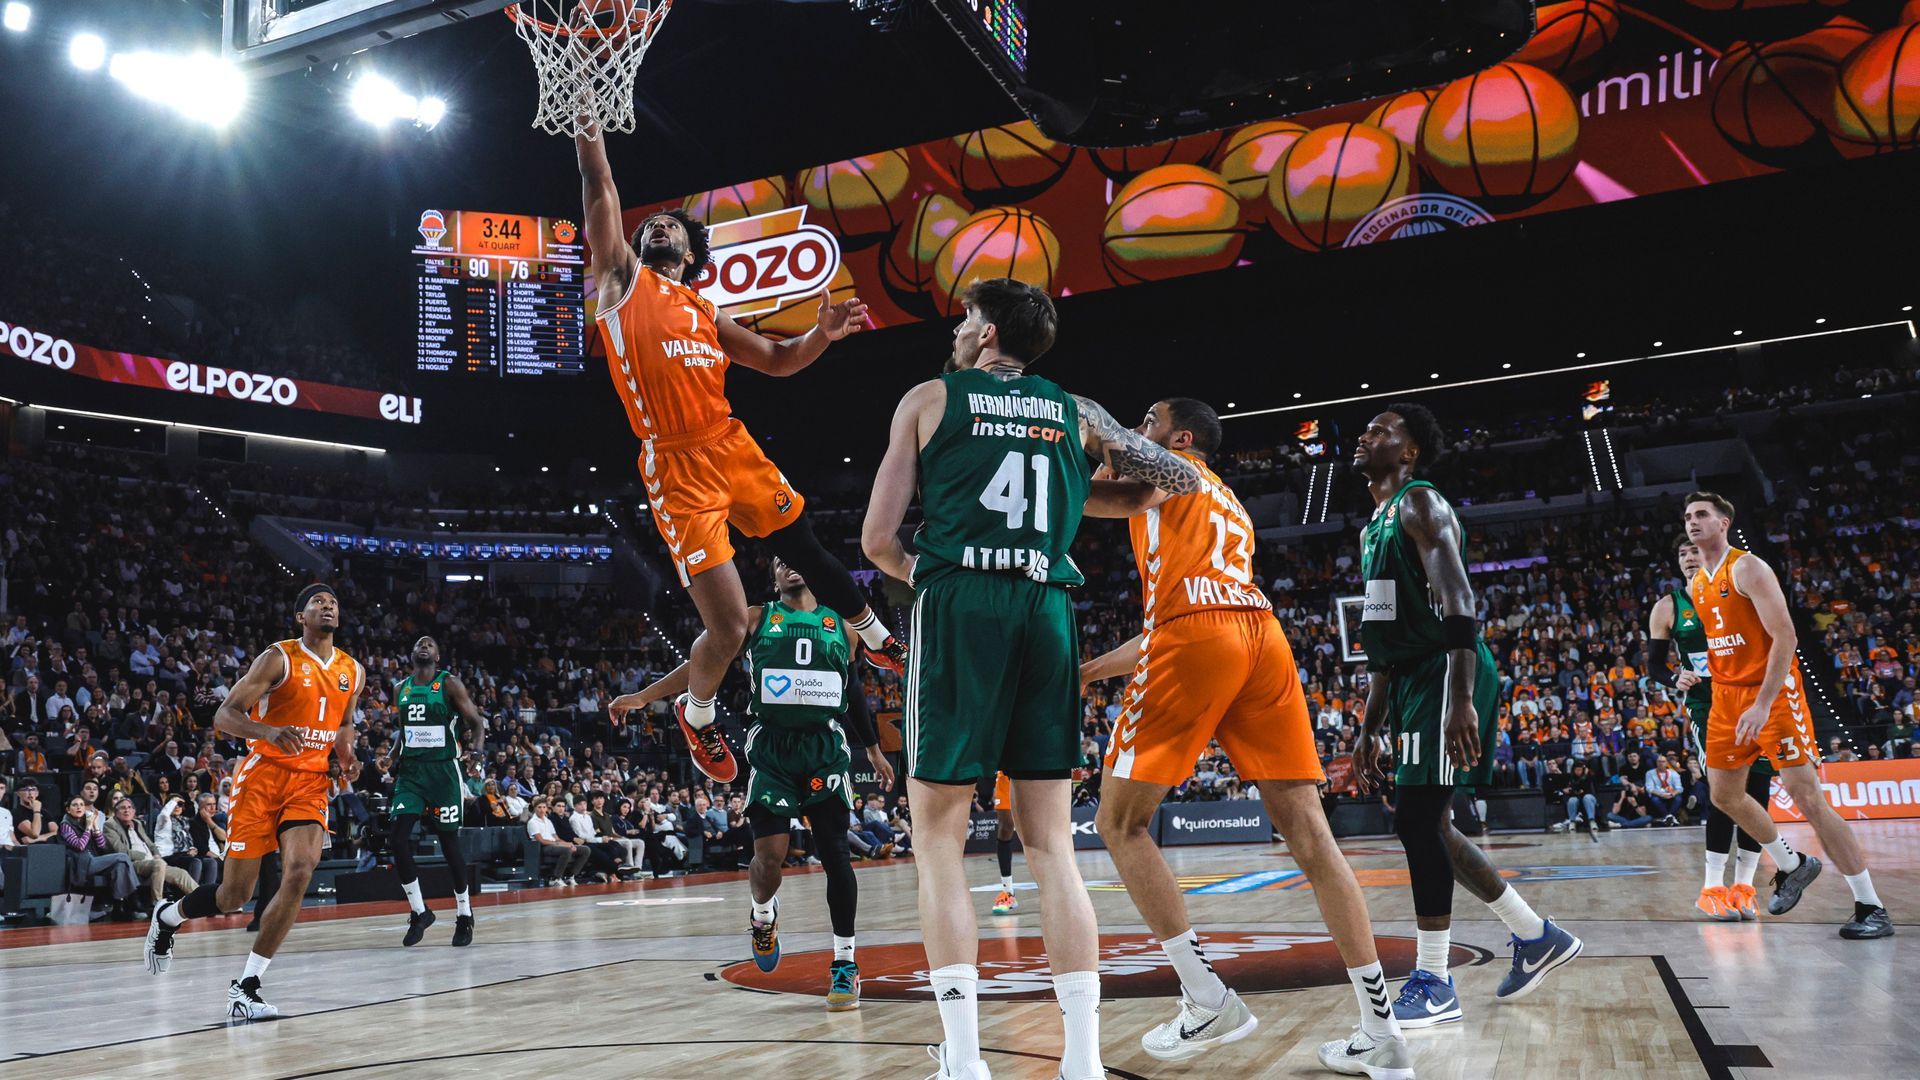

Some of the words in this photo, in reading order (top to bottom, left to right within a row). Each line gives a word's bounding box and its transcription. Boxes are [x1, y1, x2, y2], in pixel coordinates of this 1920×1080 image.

[1581, 48, 1720, 118] mili
[482, 218, 521, 240] 3:44
[1359, 204, 1439, 242] ROCINADOR
[1445, 206, 1480, 226] OFIC
[491, 242, 520, 250] QUART
[469, 258, 488, 278] 90
[509, 260, 528, 280] 76
[684, 305, 698, 332] 7
[968, 393, 1064, 424] HERNANGOMEZ
[972, 416, 1065, 443] instacar
[978, 450, 1050, 532] 41
[1210, 511, 1250, 585] 13
[962, 546, 1049, 583] ATHENS
[1712, 606, 1724, 630] 3
[795, 638, 812, 665] 0
[1708, 633, 1746, 649] LENCIA
[795, 678, 822, 687] Ομάδα
[795, 689, 840, 699] Προσφοράς
[318, 696, 327, 722] 1
[408, 704, 426, 721] 22
[290, 725, 337, 742] LENCIA
[1401, 732, 1420, 765] 11
[1781, 736, 1800, 760] 3
[440, 805, 459, 823] 22
[1071, 821, 1098, 834] K
